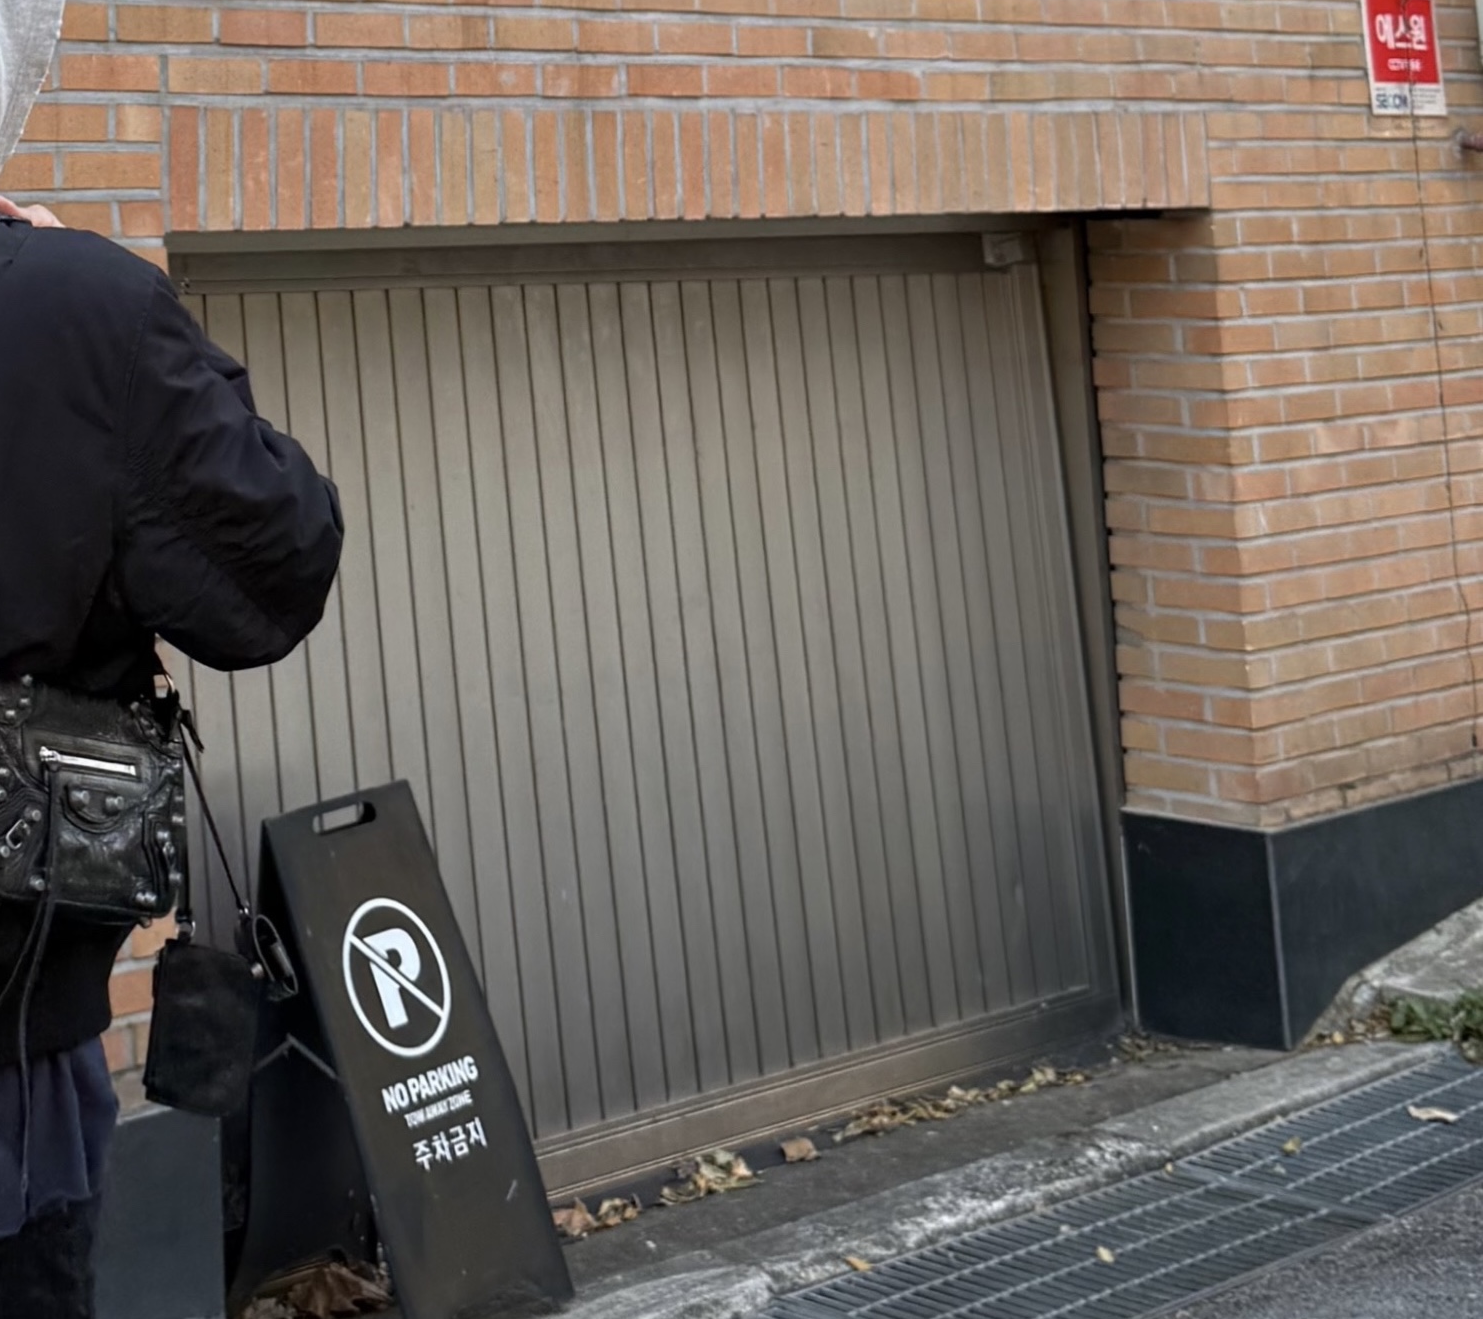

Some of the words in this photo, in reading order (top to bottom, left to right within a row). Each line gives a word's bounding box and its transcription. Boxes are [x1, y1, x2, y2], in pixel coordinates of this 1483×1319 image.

[1374, 13, 1429, 52] 에스원
[381, 1082, 409, 1113] NO
[407, 1055, 479, 1103] PARKING
[448, 1089, 473, 1111] ZONE
[412, 1116, 488, 1171] 주차금지
